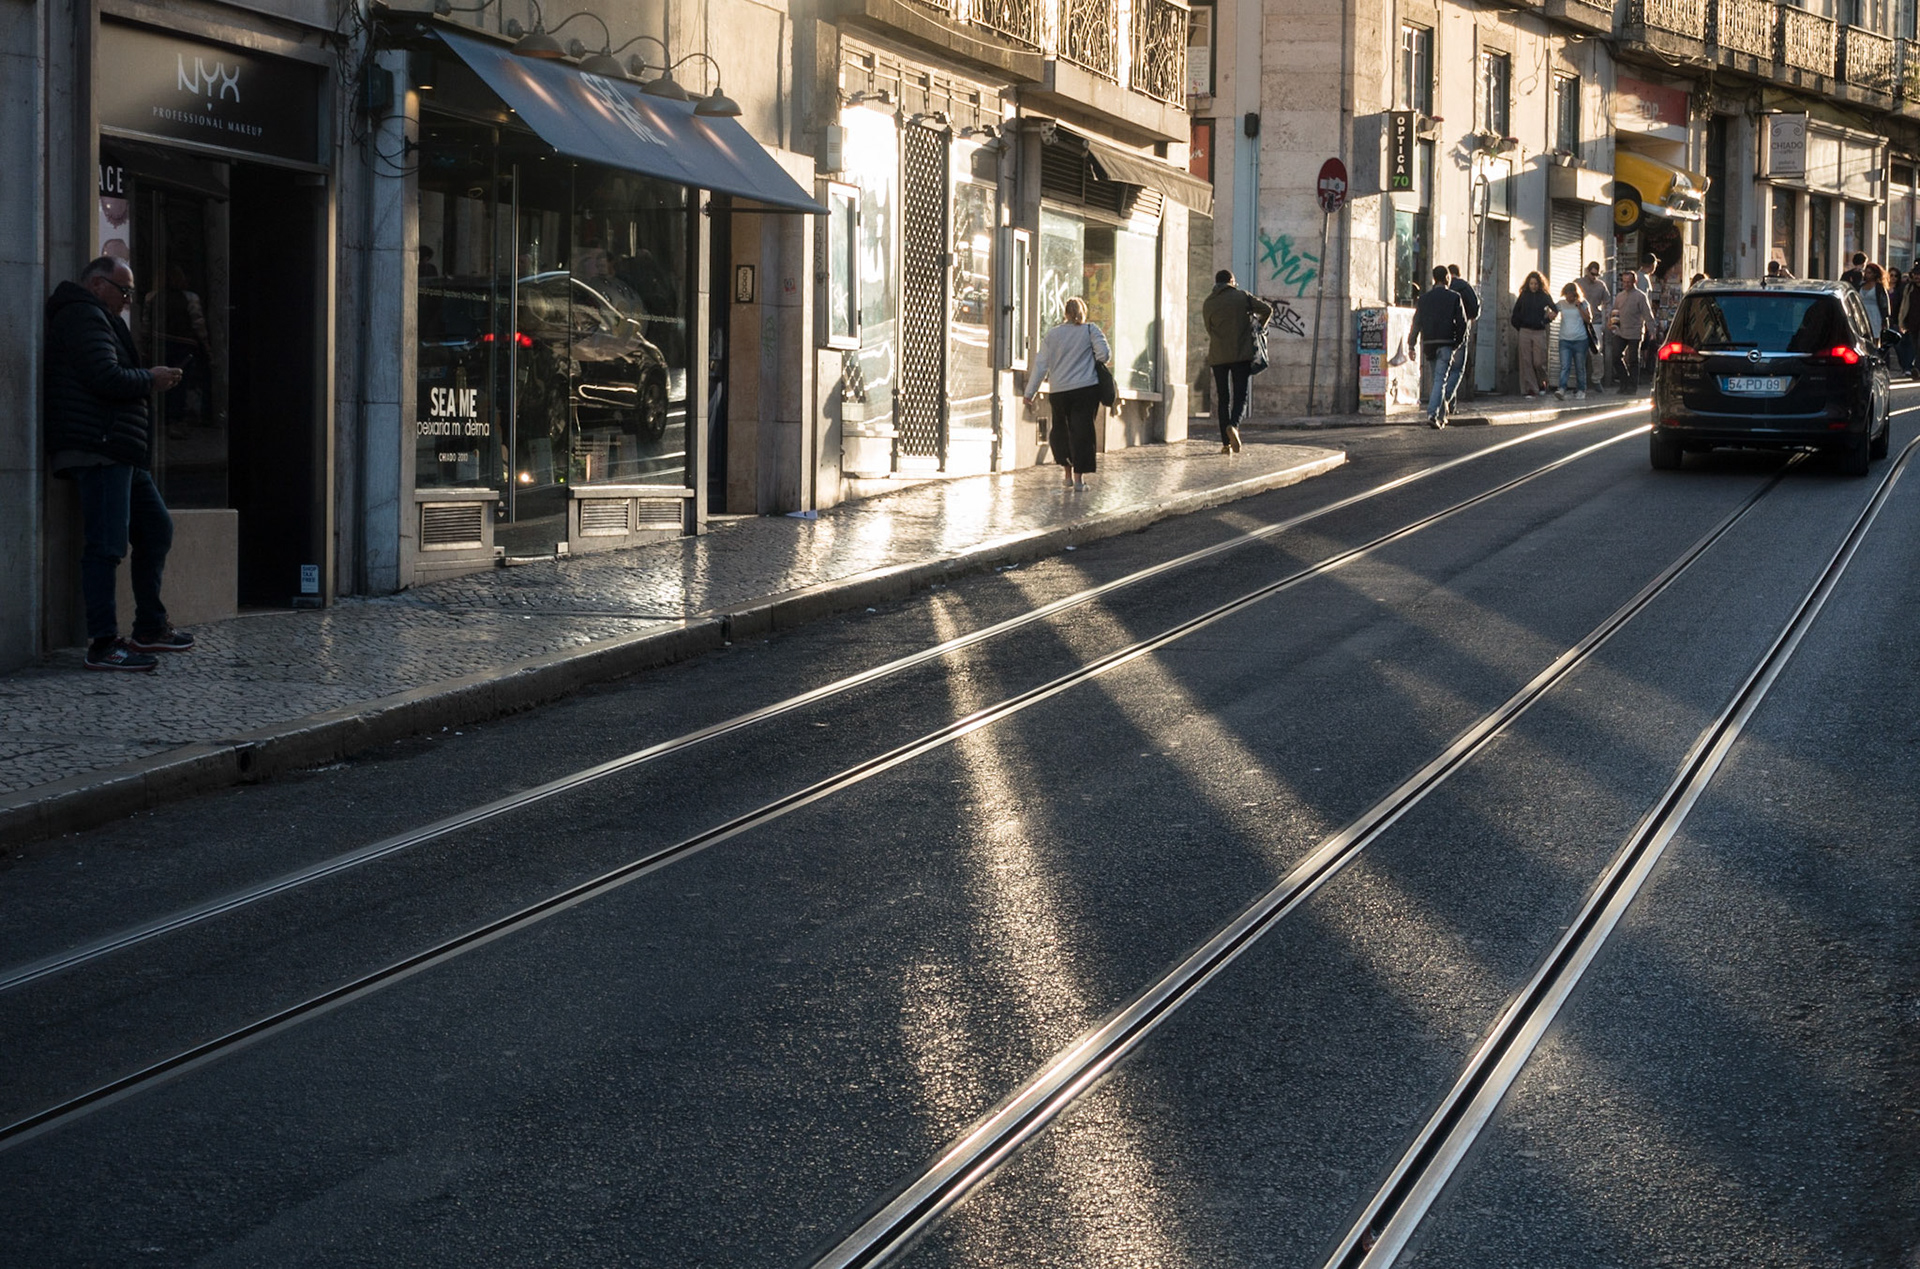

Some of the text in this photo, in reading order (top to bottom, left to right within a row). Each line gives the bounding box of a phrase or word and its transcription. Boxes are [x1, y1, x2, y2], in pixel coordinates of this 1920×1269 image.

[177, 53, 240, 103] NYX
[152, 106, 263, 137] PROFESSIONAL MAKEUP
[1396, 116, 1406, 174] OPTICA
[1770, 140, 1804, 150] CHIADO
[1392, 175, 1410, 188] 70
[430, 386, 478, 418] SEA ME
[416, 417, 450, 439] peixaria
